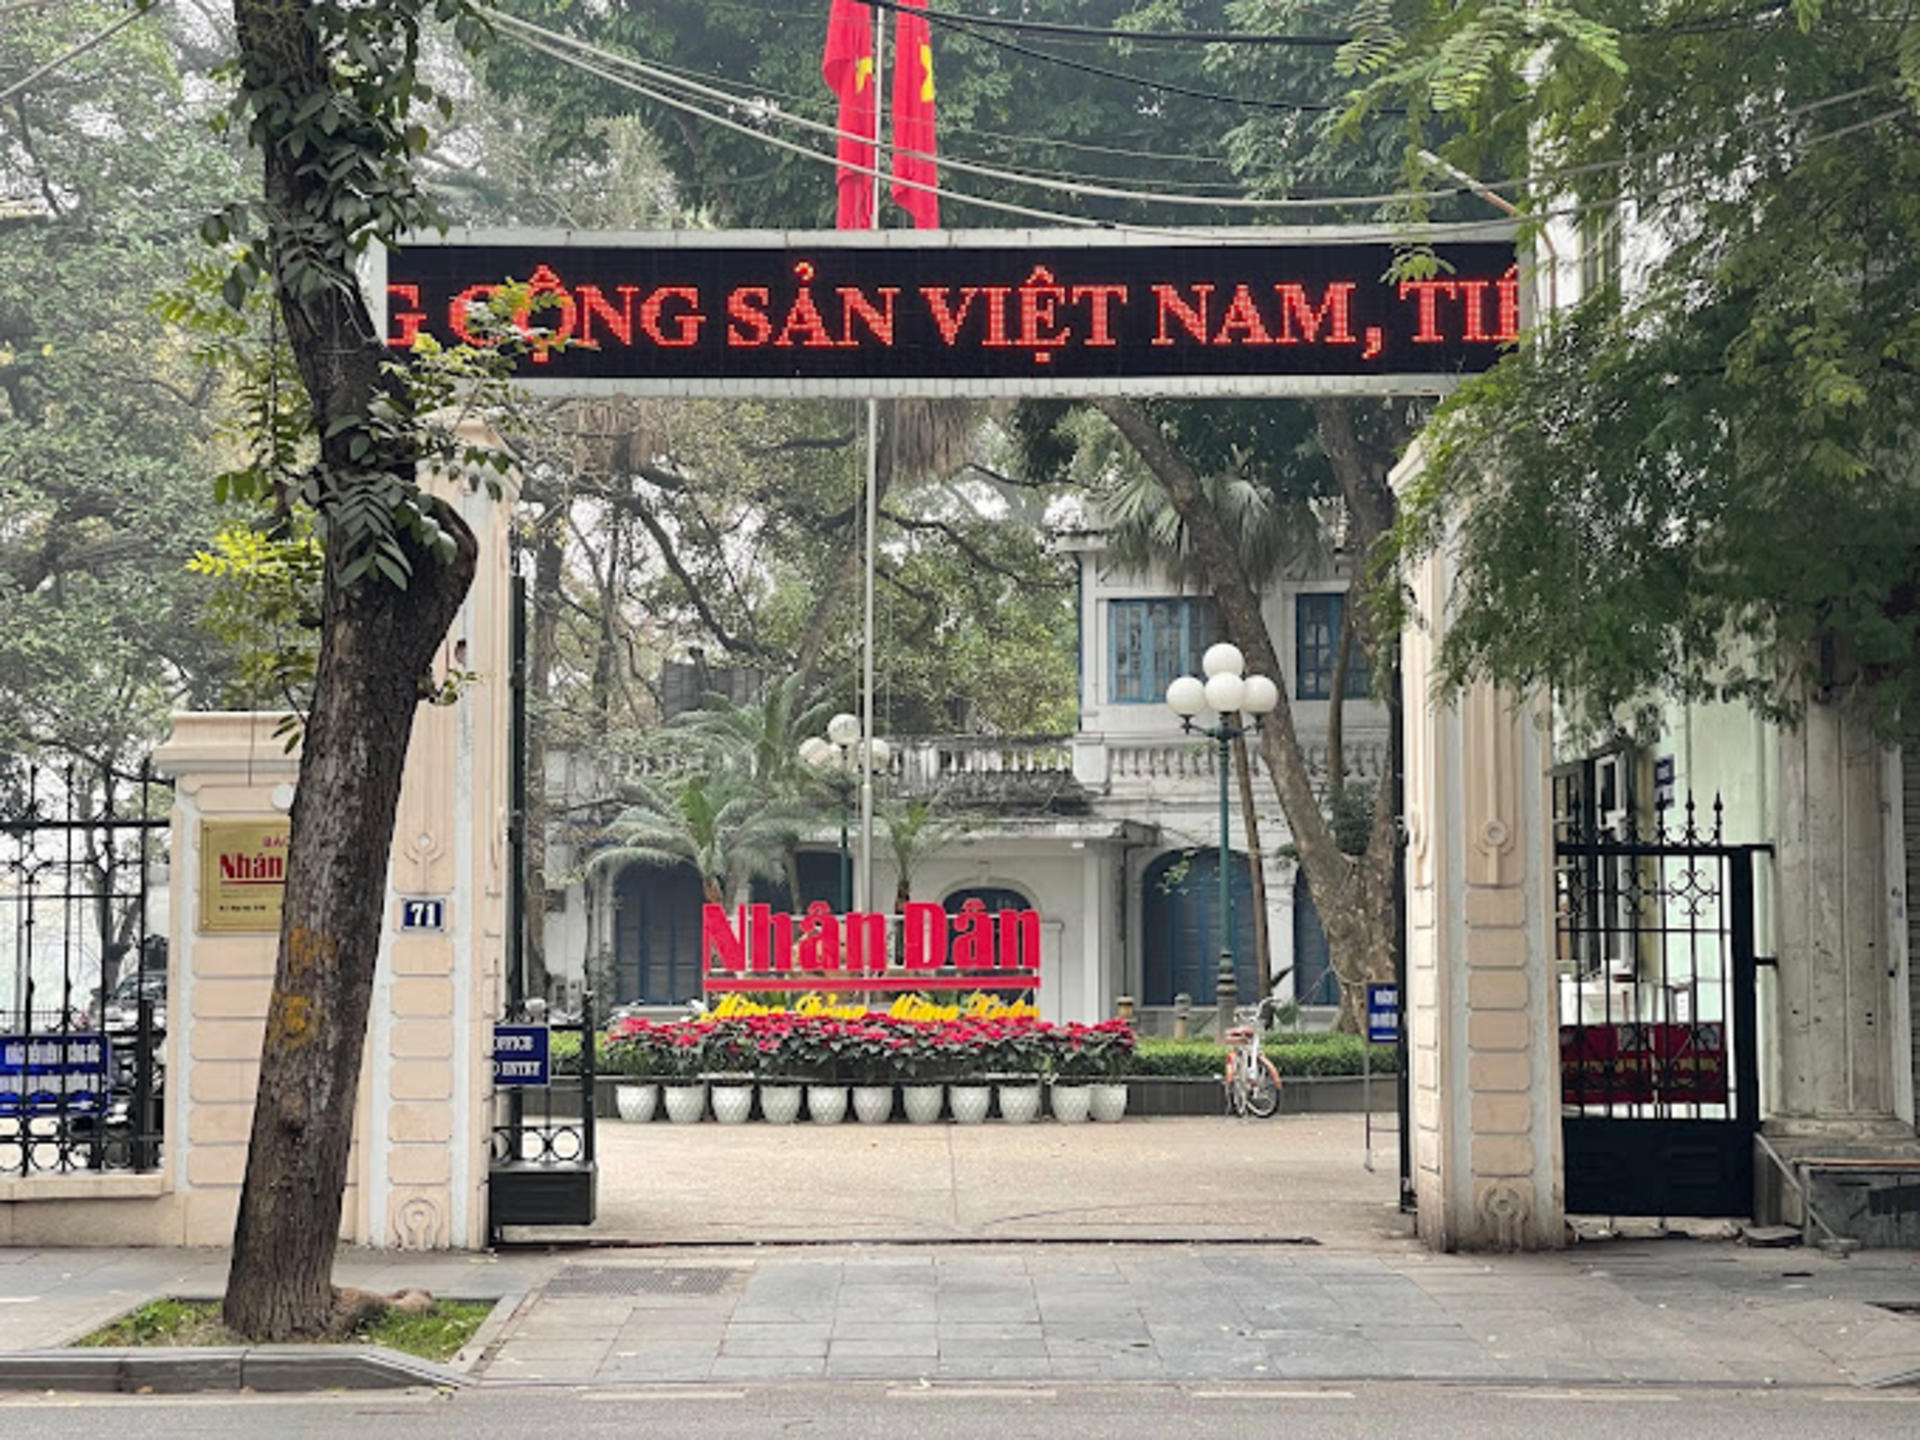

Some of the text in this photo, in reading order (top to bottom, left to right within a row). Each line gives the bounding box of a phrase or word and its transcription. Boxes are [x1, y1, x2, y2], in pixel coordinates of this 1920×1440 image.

[448, 264, 706, 364] CỘNG
[725, 261, 902, 349] SẢN
[919, 264, 1129, 364] VIỆT
[1150, 281, 1384, 360] NAM,
[219, 852, 283, 879] Nhân
[410, 902, 437, 927] 71
[702, 898, 1041, 972] Nhân Dân
